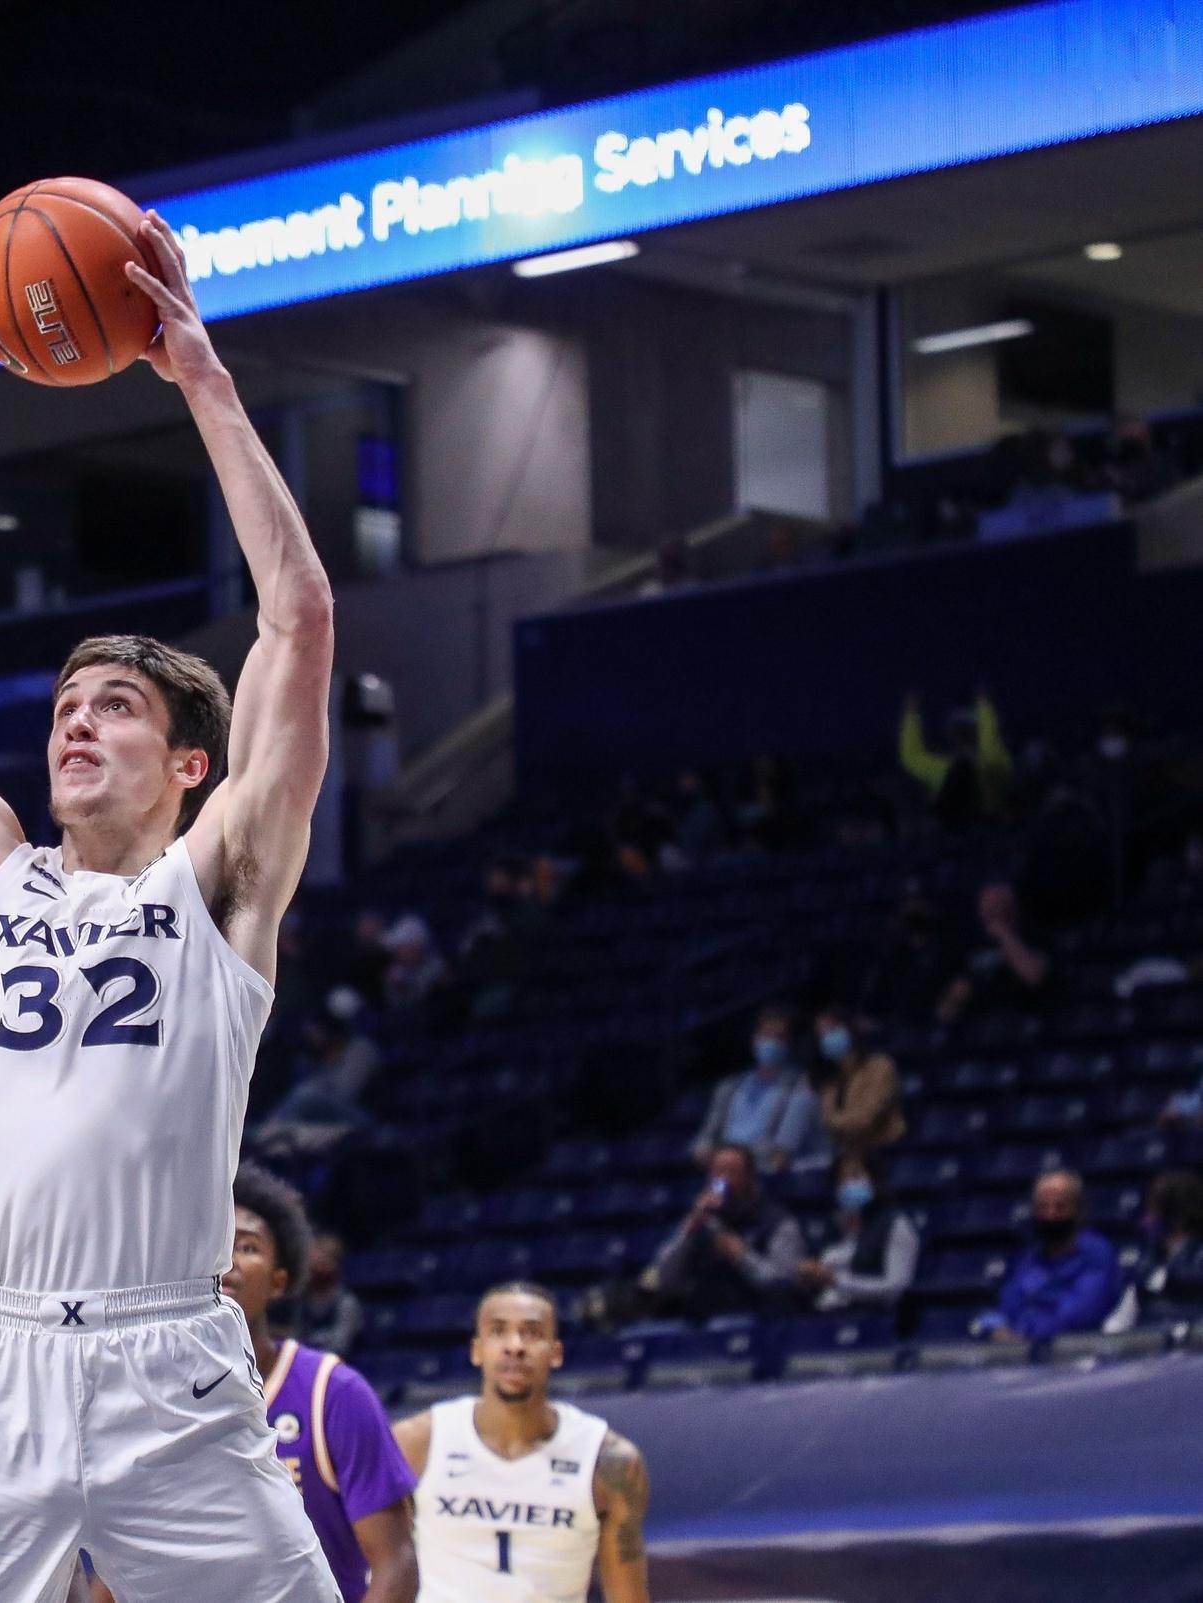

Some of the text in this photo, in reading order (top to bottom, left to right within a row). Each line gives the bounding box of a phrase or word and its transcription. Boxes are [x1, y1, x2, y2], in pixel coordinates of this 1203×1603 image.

[170, 102, 810, 283] irement Planning Services
[60, 1301, 86, 1326] X
[436, 1496, 576, 1528] XAVIER
[494, 1531, 511, 1574] 1
